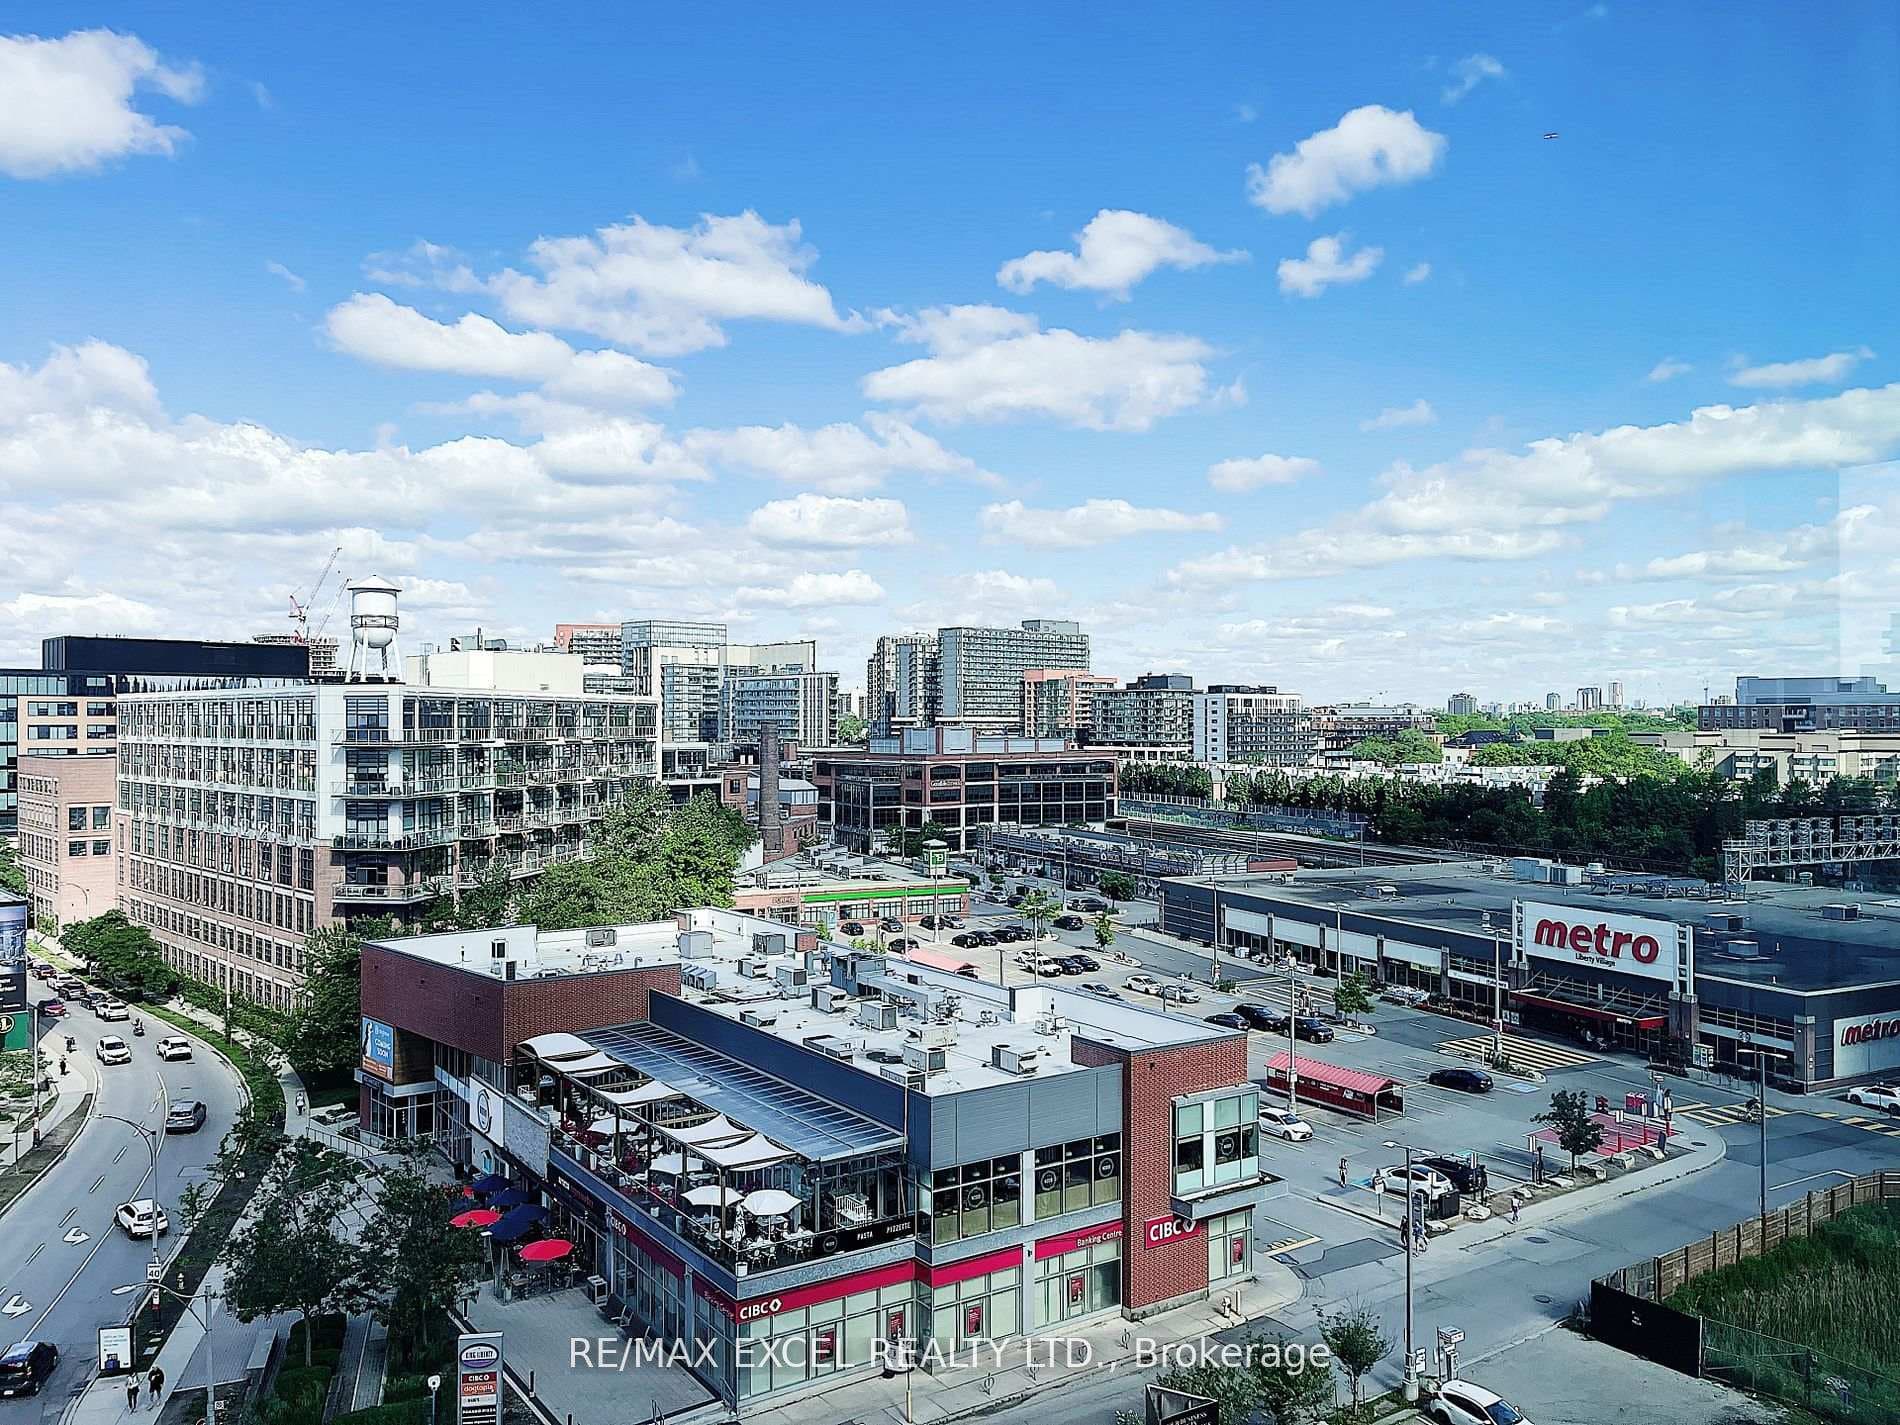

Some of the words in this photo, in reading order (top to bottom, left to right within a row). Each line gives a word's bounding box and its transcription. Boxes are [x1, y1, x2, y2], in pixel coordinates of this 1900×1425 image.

[1535, 918, 1659, 963] metro
[1575, 953, 1595, 964] Liberty
[1596, 957, 1616, 968] Village
[1840, 1018, 1900, 1046] metro
[857, 1231, 873, 1241] PASTA
[1077, 1234, 1102, 1247] Banking
[1102, 1230, 1123, 1242] Centre
[1149, 1219, 1182, 1241] CIBC
[148, 1270, 160, 1278] 40
[739, 1301, 769, 1320] CIBC
